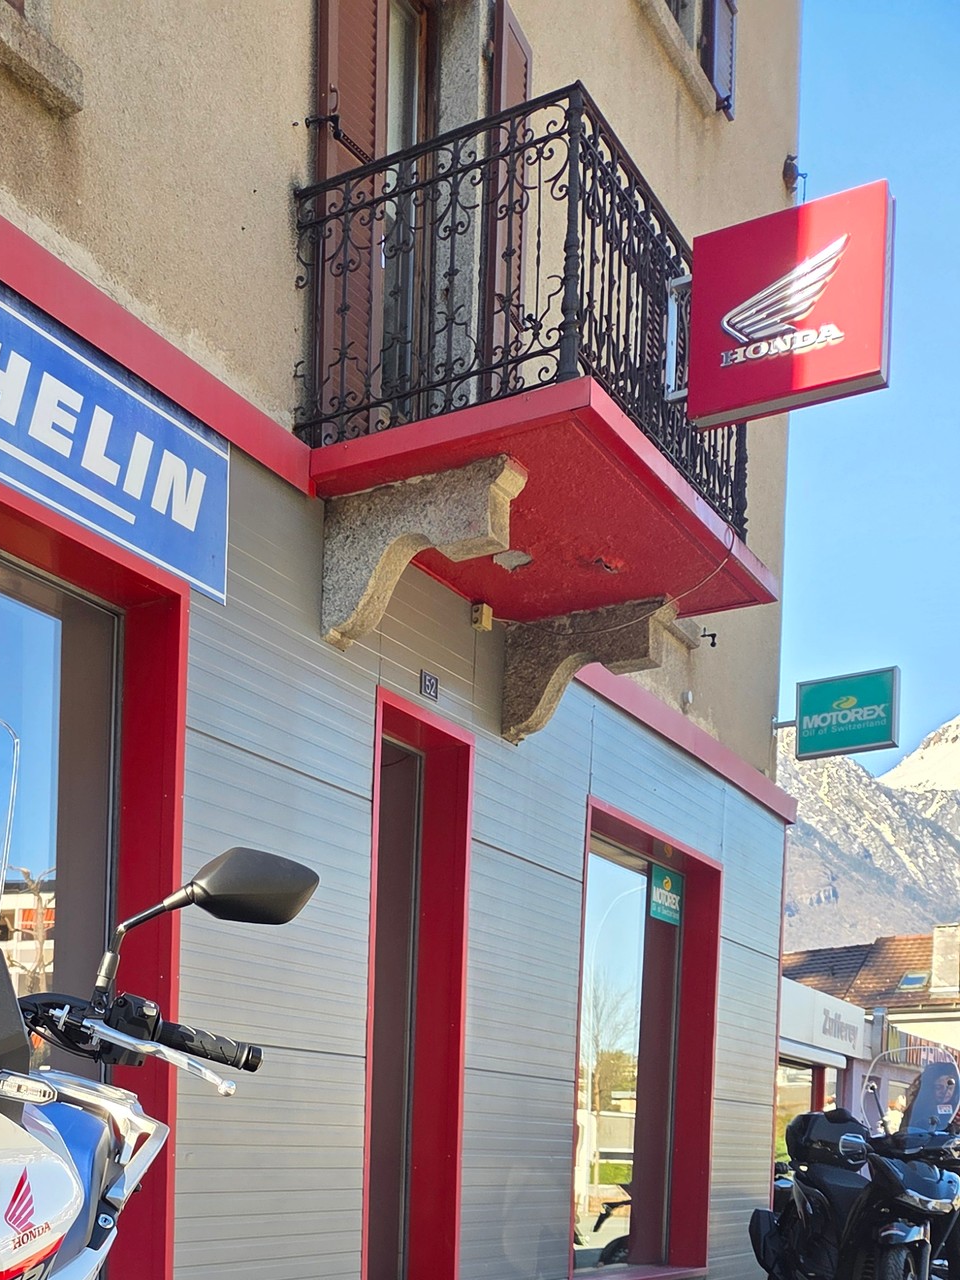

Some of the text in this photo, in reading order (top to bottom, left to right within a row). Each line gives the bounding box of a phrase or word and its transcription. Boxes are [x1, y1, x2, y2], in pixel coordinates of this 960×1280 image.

[720, 324, 845, 367] HONDA
[425, 675, 436, 696] 52
[802, 703, 886, 730] MOTOREX
[802, 718, 887, 738] Oil of Switzerland
[12, 1222, 52, 1251] HONDA
